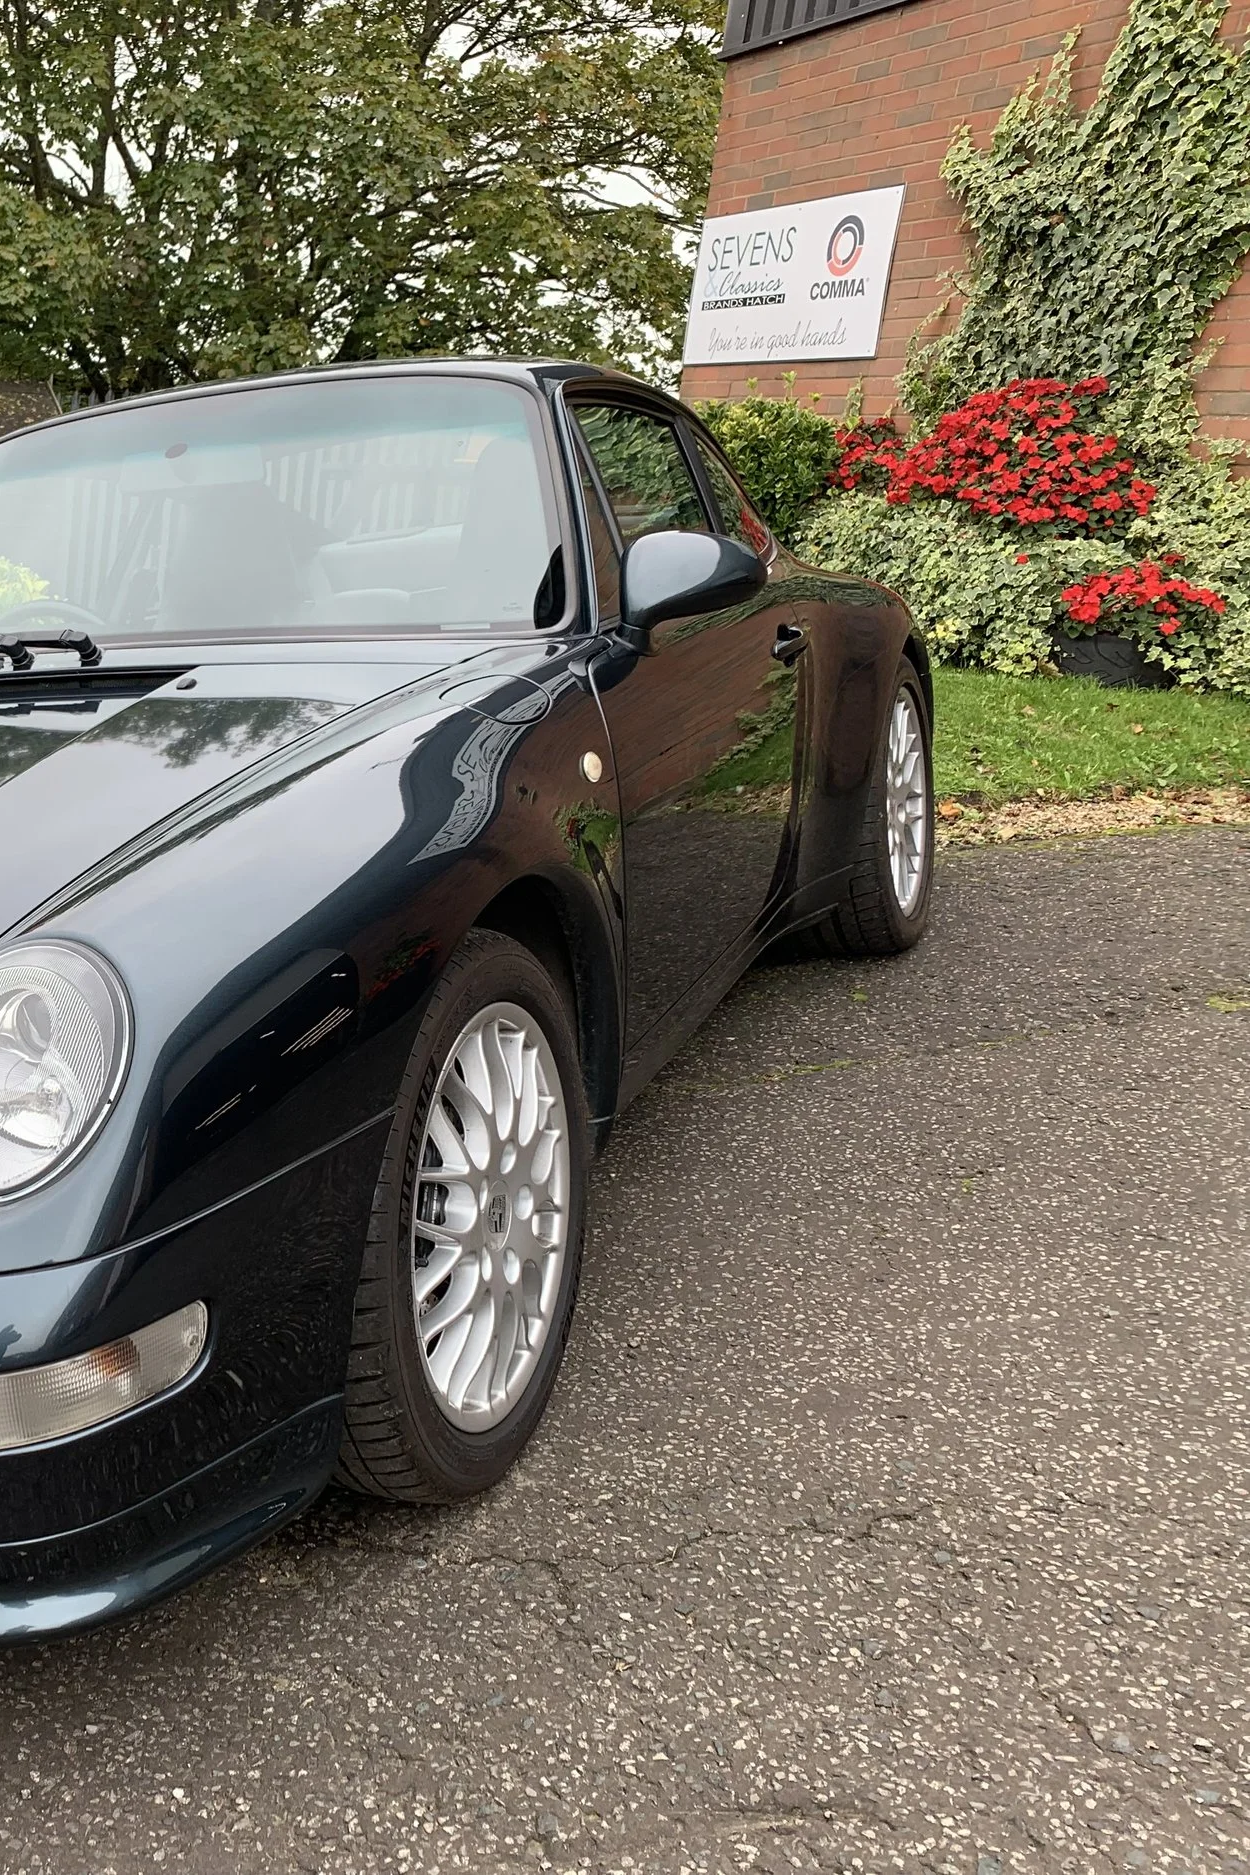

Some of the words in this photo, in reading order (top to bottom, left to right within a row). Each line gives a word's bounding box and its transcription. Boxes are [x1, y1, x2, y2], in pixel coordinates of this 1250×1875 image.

[707, 226, 797, 272] SEVENS
[718, 271, 784, 298] Classics
[810, 278, 865, 300] COMMA
[703, 297, 744, 311] BRANDS
[746, 294, 784, 306] HATCH
[707, 325, 747, 359] You're
[750, 331, 765, 349] in
[766, 321, 802, 358] good
[801, 317, 847, 347] hands
